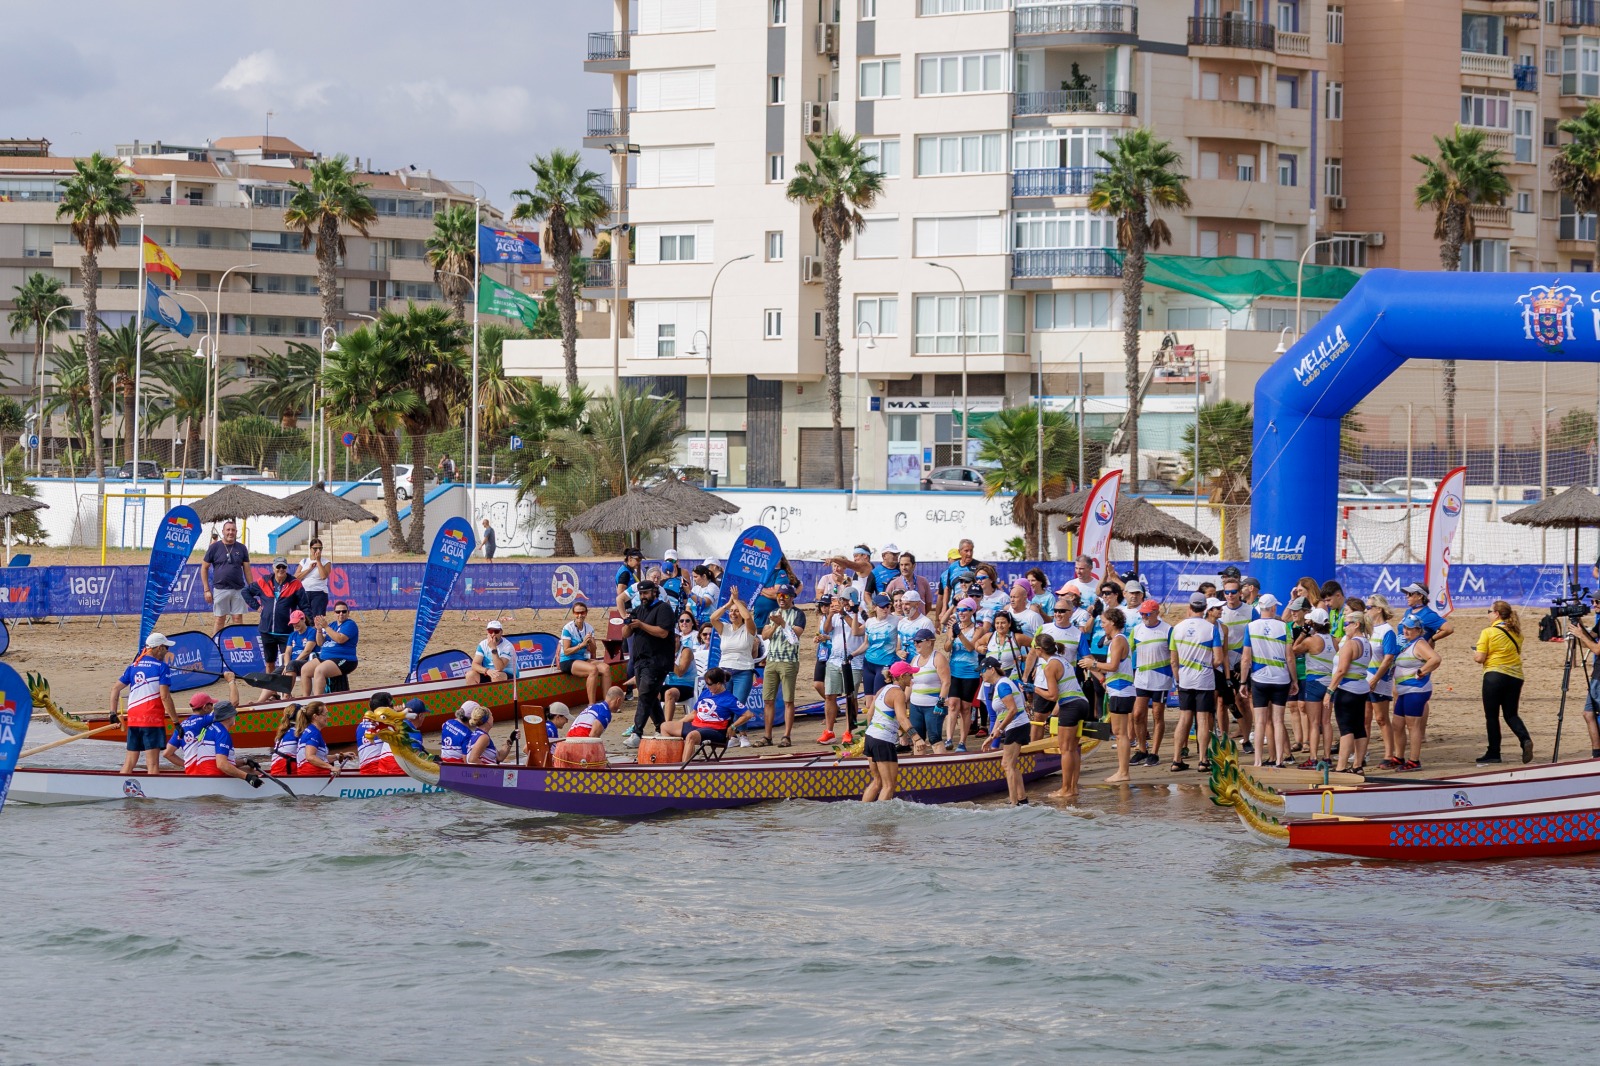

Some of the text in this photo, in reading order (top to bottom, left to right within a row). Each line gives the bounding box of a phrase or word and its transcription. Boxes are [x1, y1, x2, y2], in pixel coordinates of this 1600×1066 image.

[496, 242, 524, 253] AGUA
[1293, 324, 1346, 382] MELILLA
[700, 442, 724, 450] ALUILA
[926, 510, 966, 524] EAGLES
[164, 530, 190, 544] AGUA
[1250, 533, 1306, 553] MELILLA
[440, 544, 464, 559] AGUA
[739, 554, 768, 570] AGUA
[78, 597, 100, 608] viajes
[168, 595, 184, 605] ajes
[230, 650, 254, 663] ADESP
